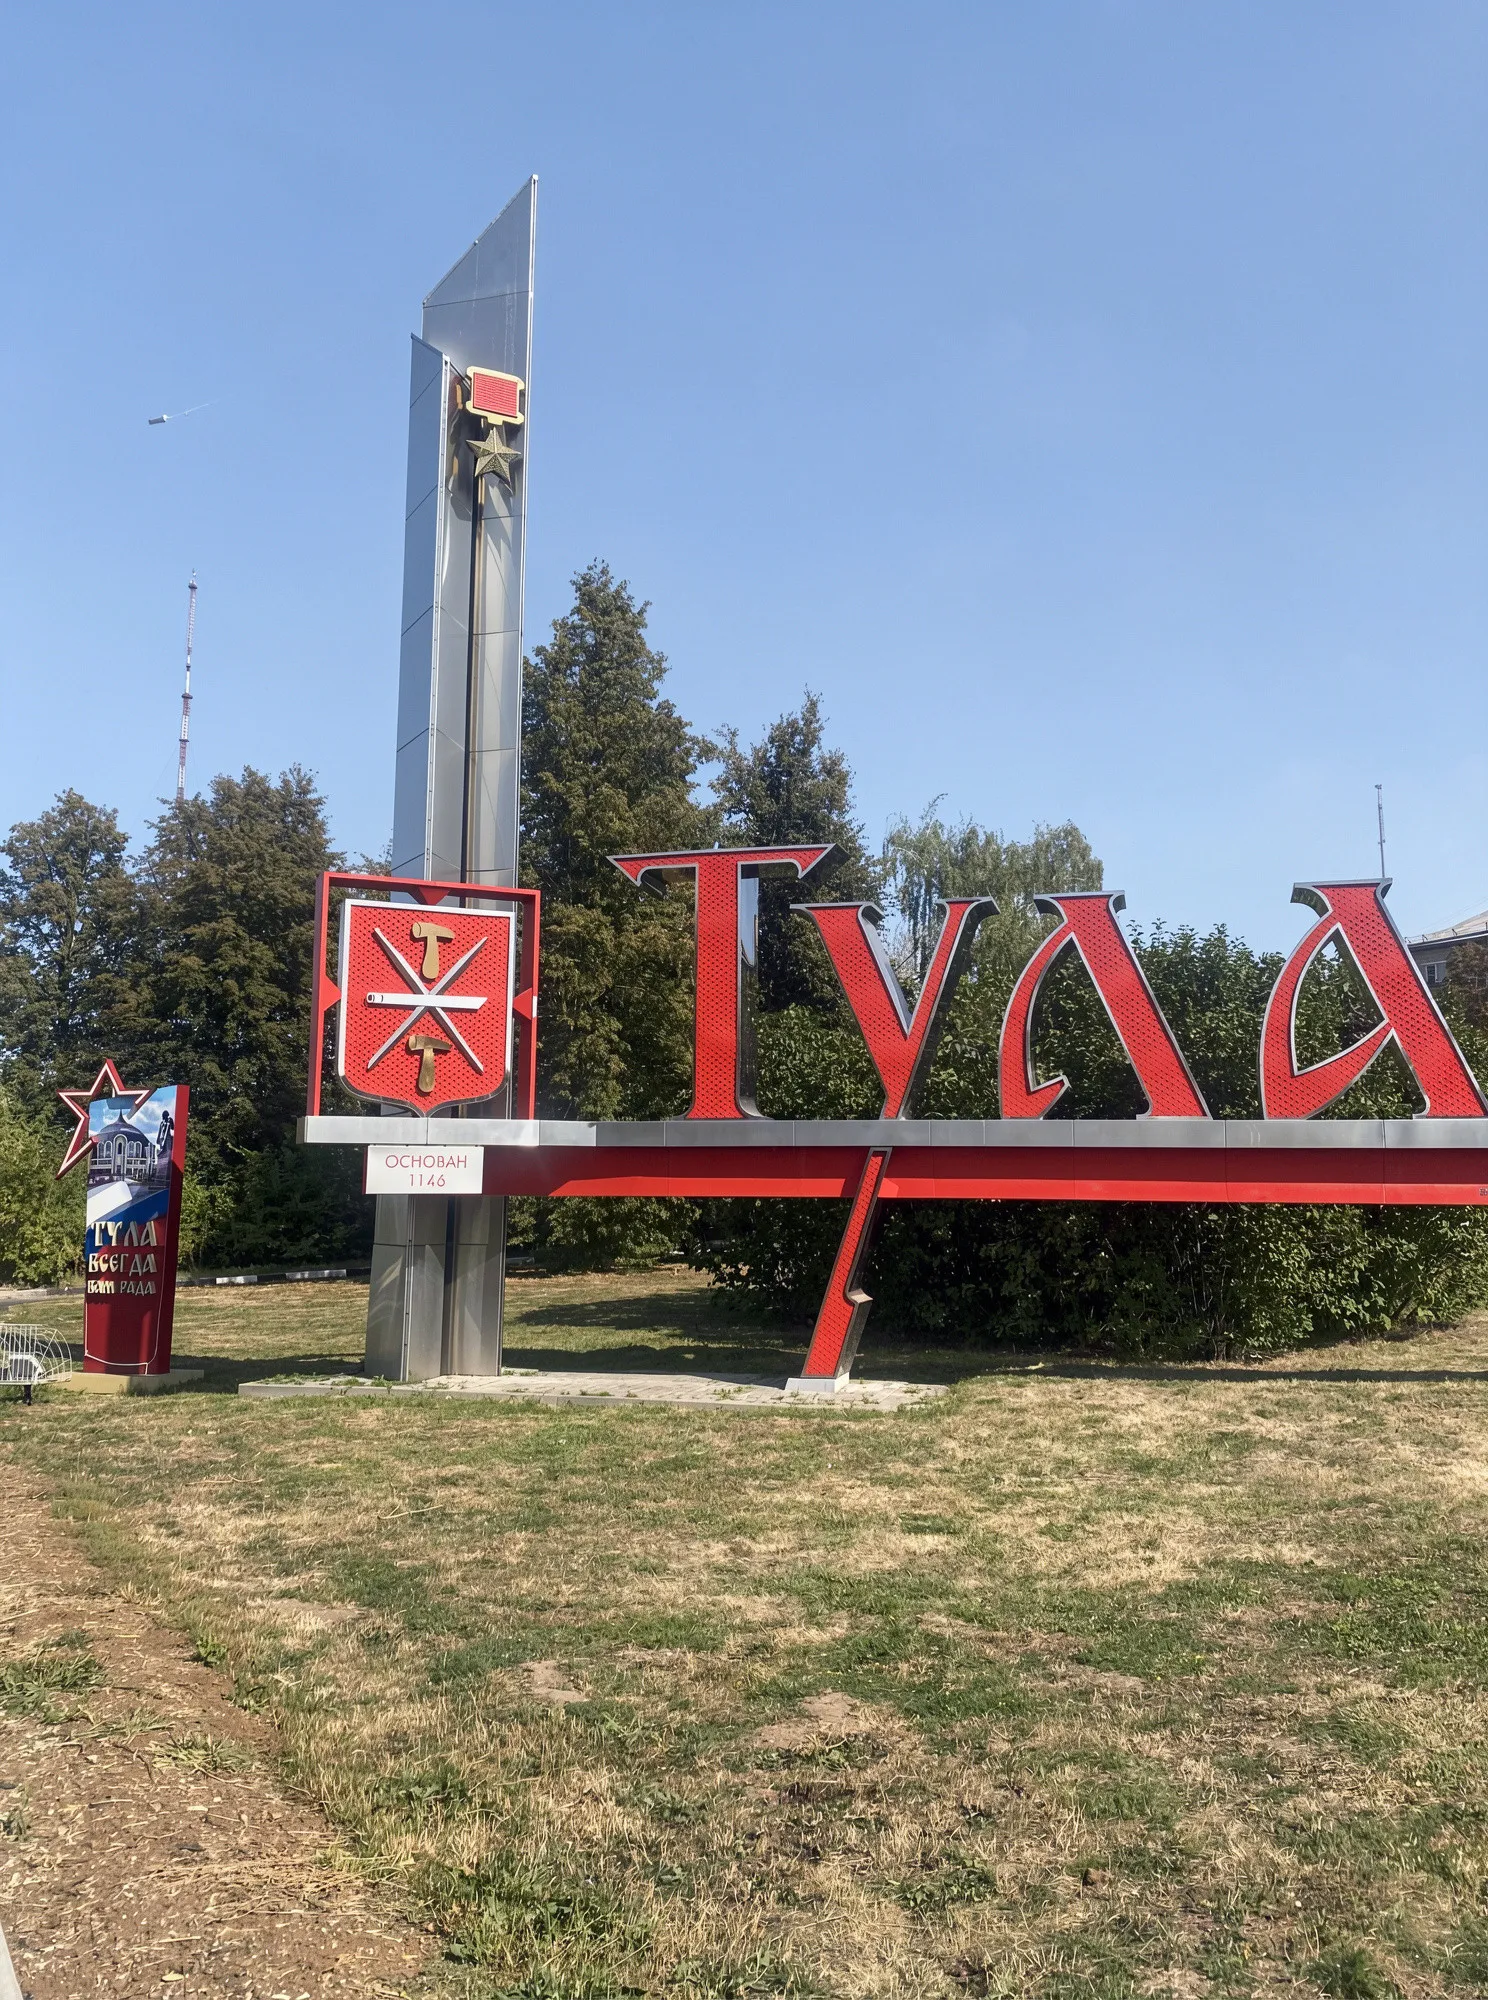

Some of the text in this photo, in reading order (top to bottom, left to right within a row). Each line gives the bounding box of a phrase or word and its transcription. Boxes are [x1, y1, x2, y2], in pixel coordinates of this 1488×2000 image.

[385, 1154, 467, 1169] ОСНОВАН
[409, 1173, 446, 1188] 1146
[91, 1220, 157, 1247] ТУЛА
[88, 1252, 157, 1277] ВСЕГДА
[120, 1280, 157, 1296] РАДА
